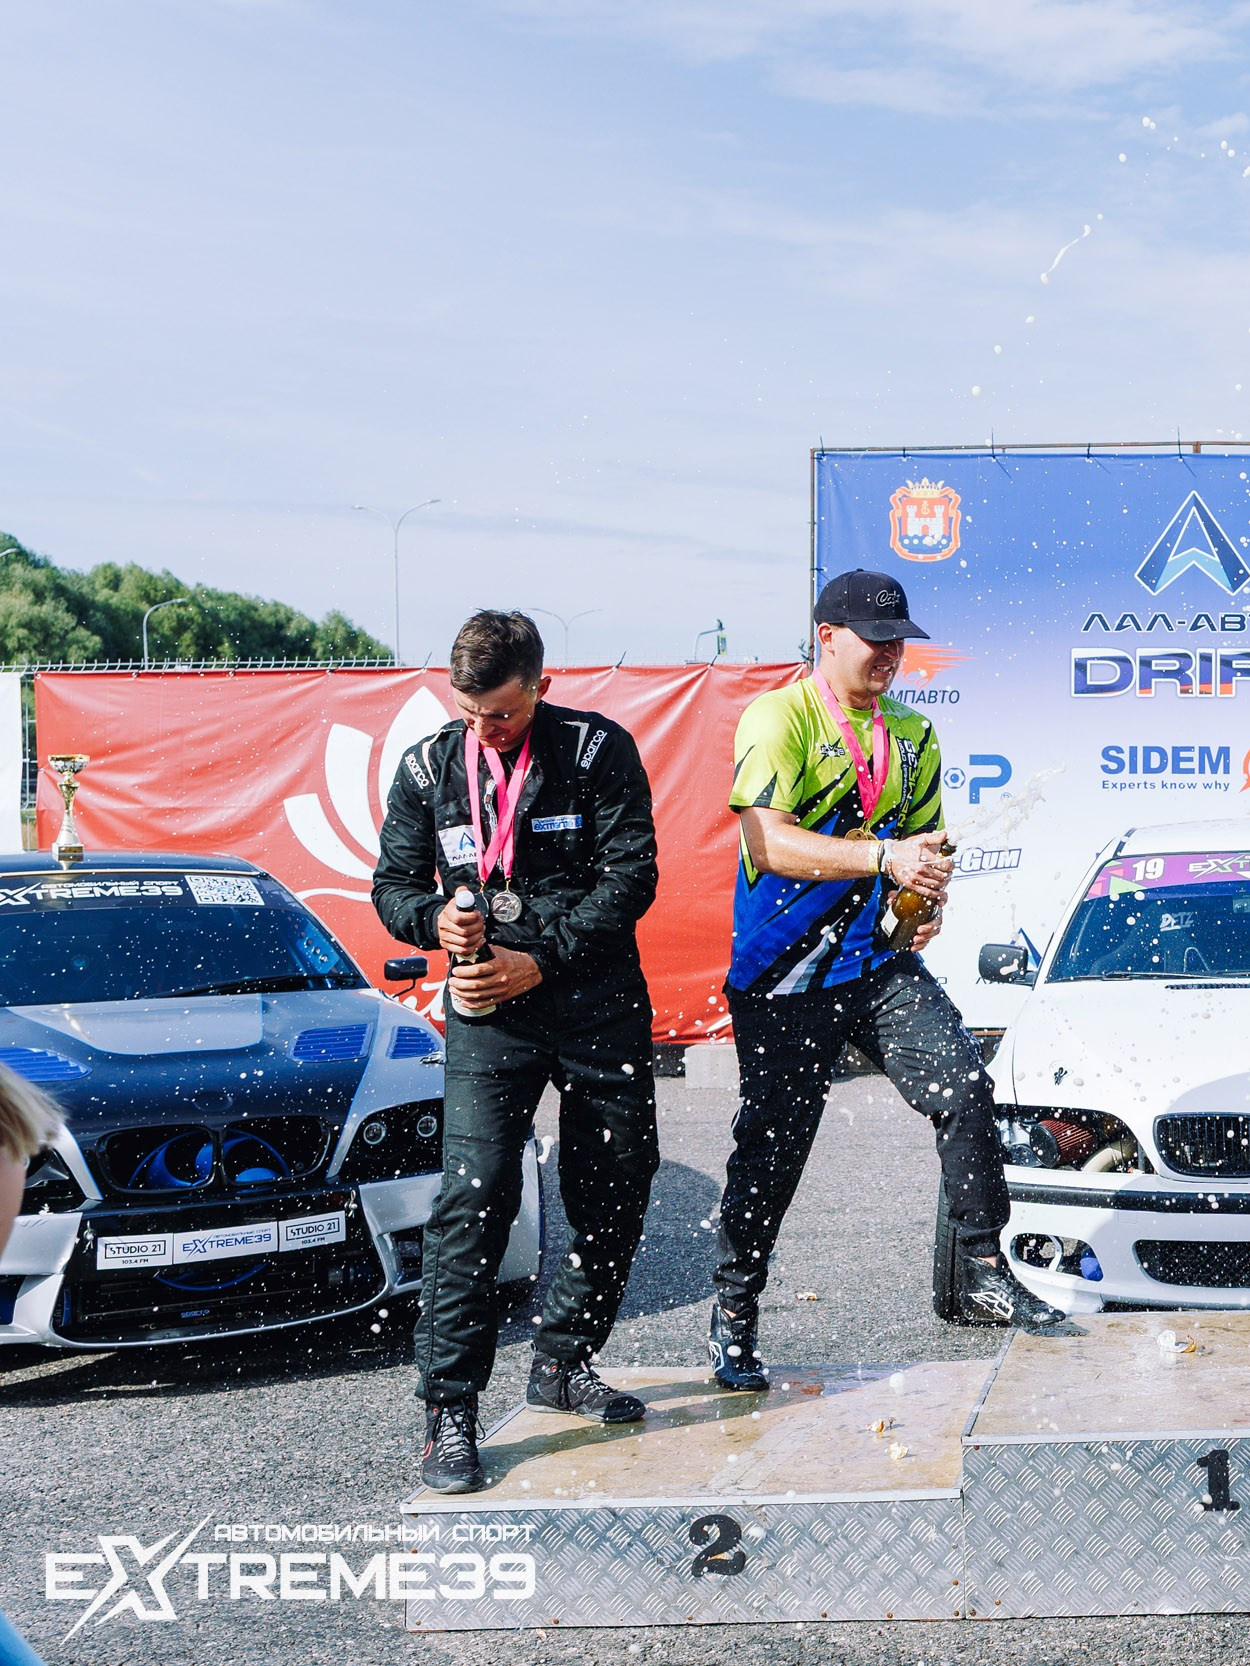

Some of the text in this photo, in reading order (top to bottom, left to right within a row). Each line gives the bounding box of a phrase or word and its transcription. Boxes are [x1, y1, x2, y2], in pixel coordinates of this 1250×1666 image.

[885, 689, 960, 704] МПАВТО
[580, 729, 607, 769] sparco
[1100, 745, 1231, 775] SIDEM
[404, 753, 430, 789] sparco
[1102, 780, 1230, 791] Experts know why
[1132, 857, 1165, 881] 19
[0, 882, 184, 905] XTREME39
[290, 1221, 336, 1236] STUDIO 21
[110, 1243, 162, 1255] STUDIO 21
[182, 1232, 272, 1259] EXTREME39
[1197, 1449, 1240, 1511] 1
[689, 1514, 746, 1577] 2
